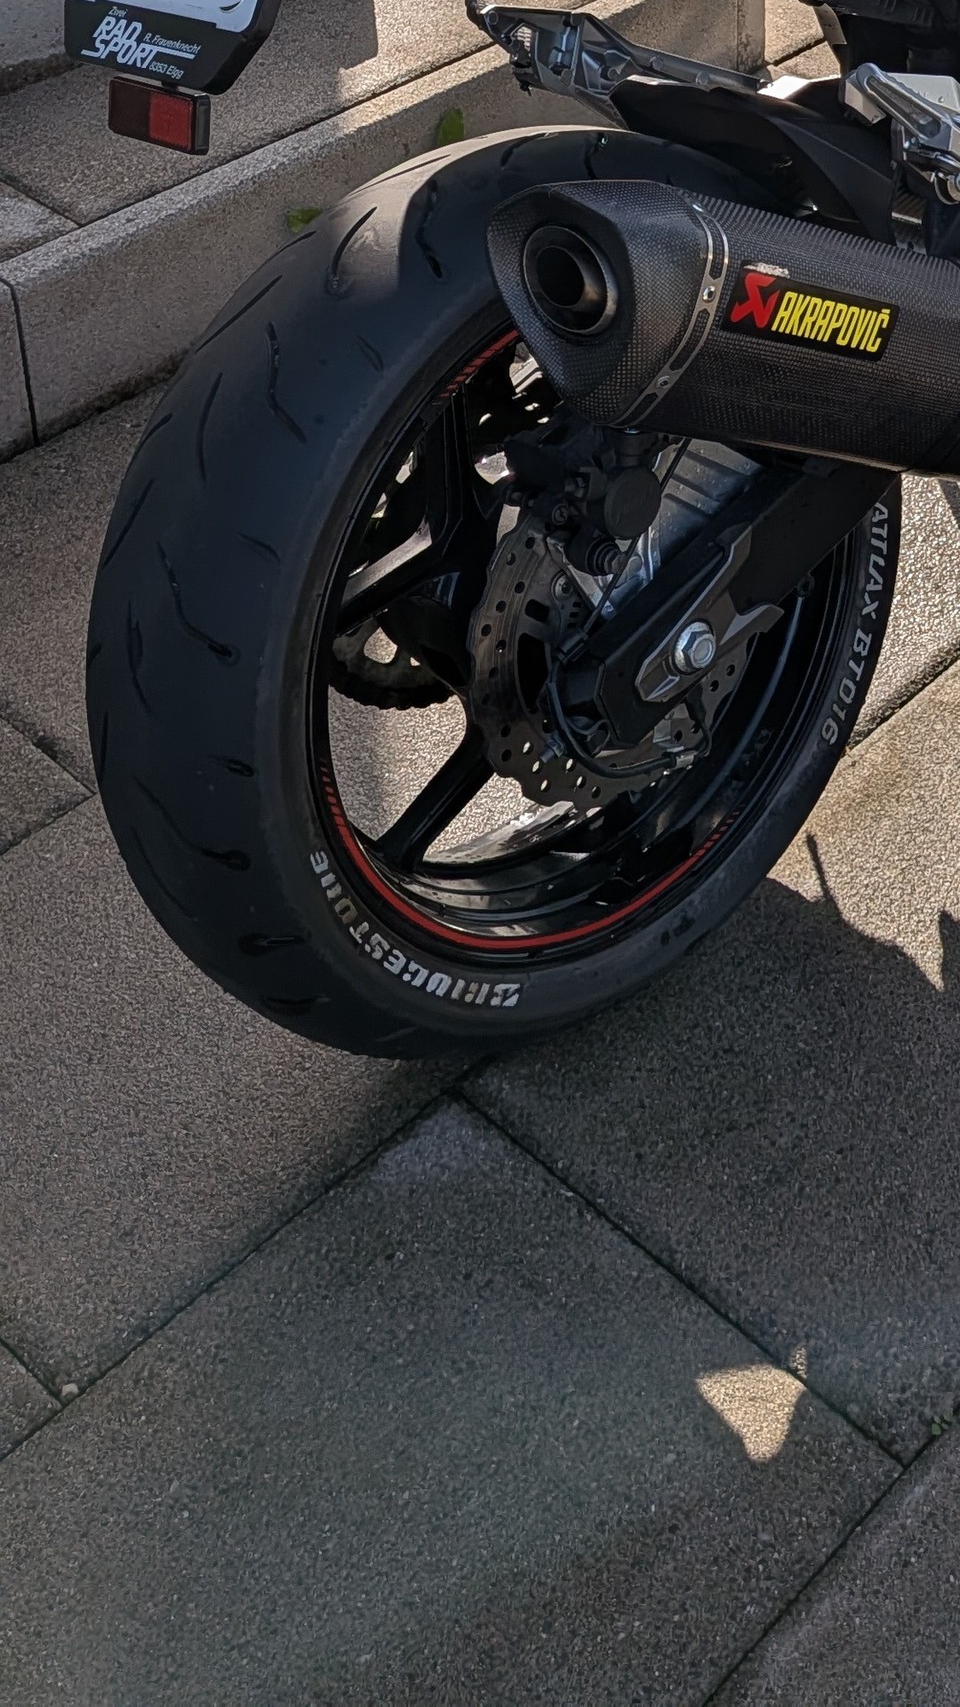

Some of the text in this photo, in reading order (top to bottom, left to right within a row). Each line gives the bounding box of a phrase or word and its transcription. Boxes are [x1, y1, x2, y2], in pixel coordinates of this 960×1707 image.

[108, 6, 128, 18] Zwei
[92, 16, 142, 42] RAD
[81, 36, 196, 69] SPORT
[861, 501, 889, 620] ATTLAX
[309, 849, 522, 1008] BRIDGESTONE
